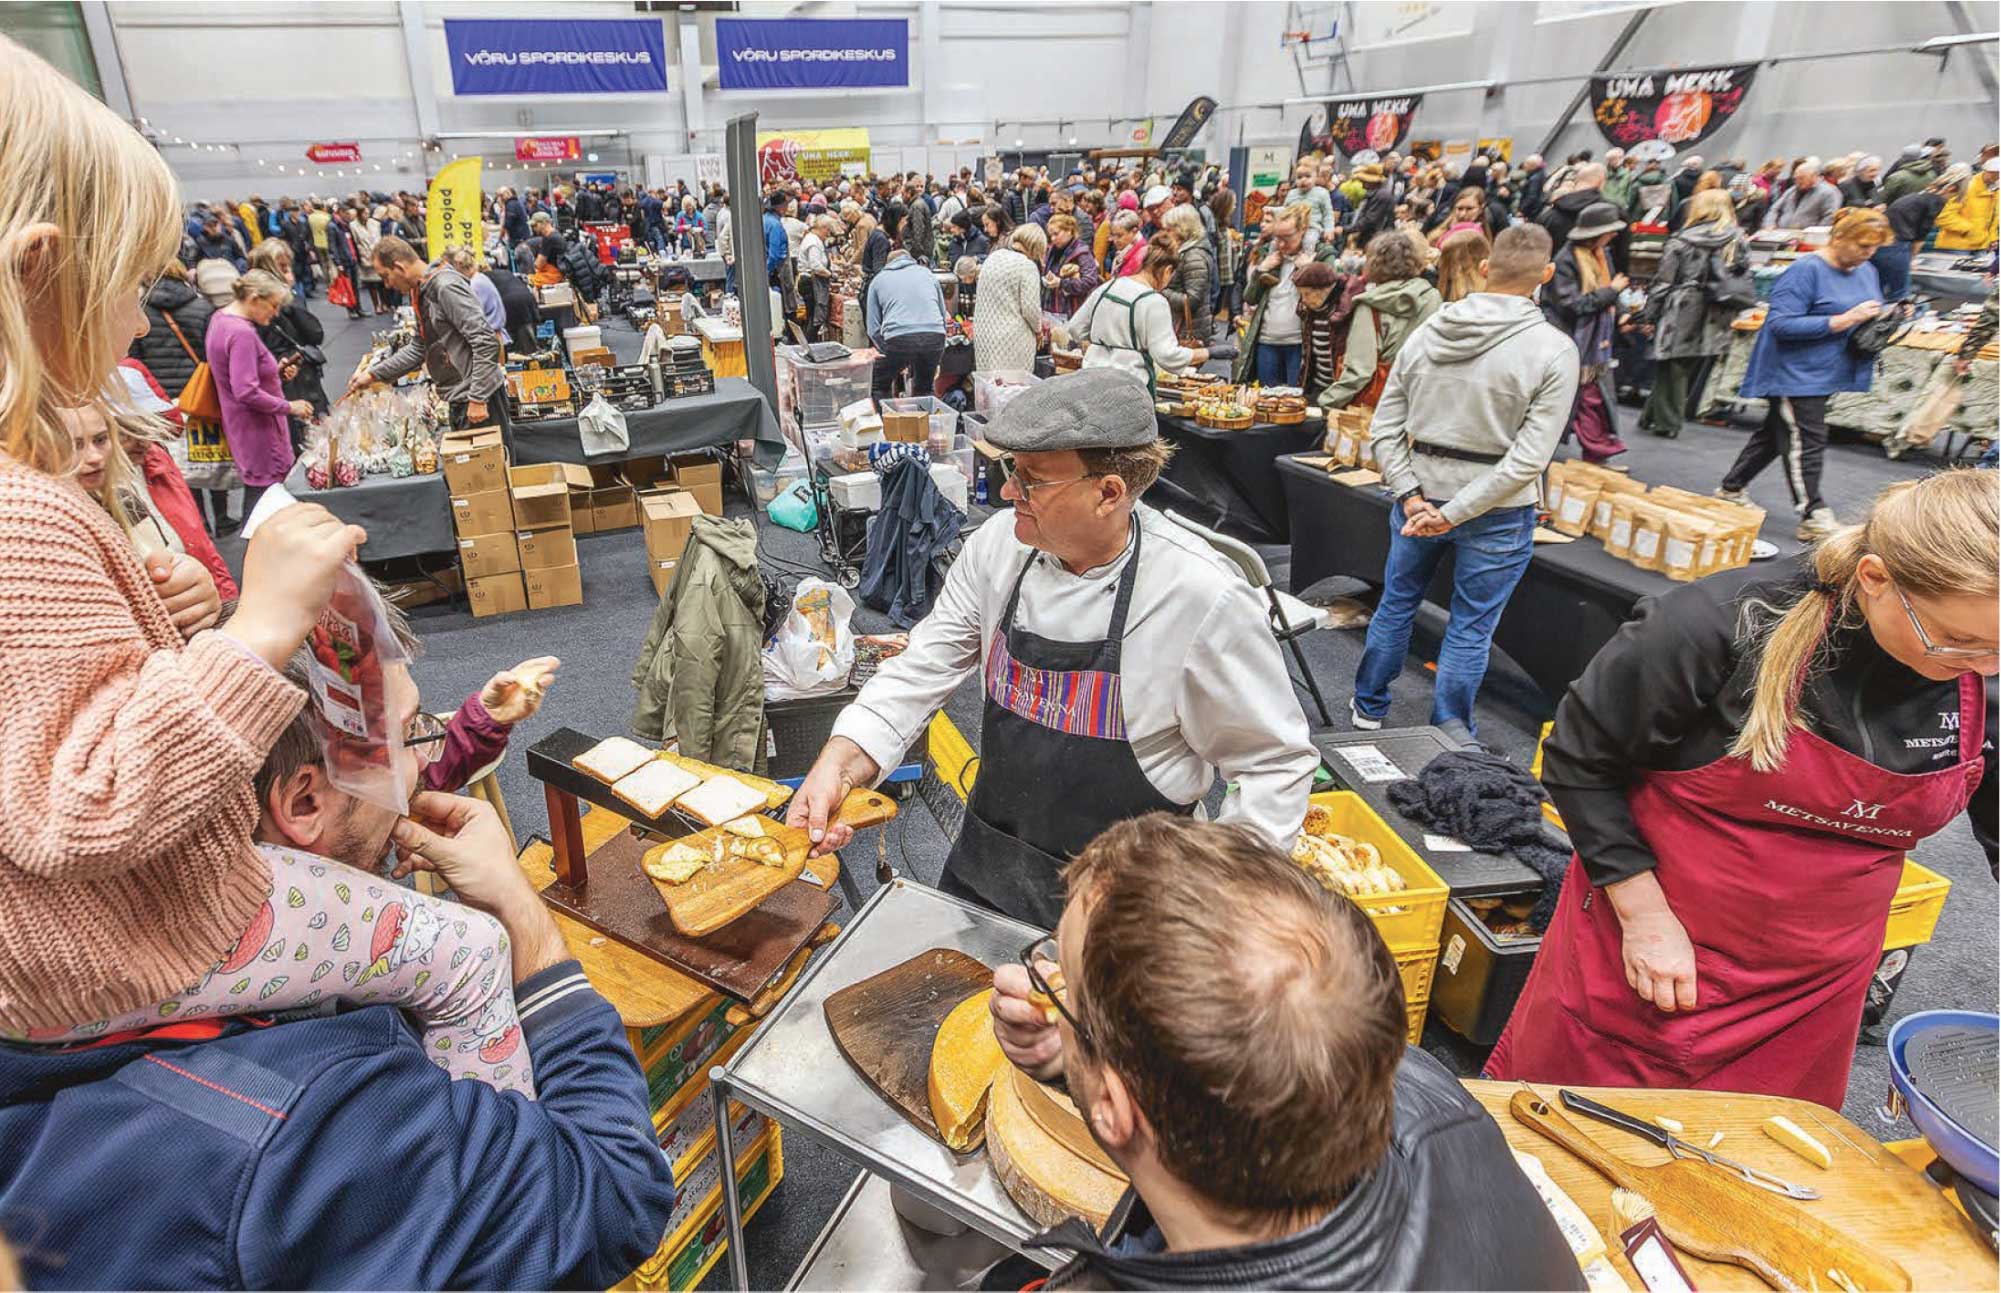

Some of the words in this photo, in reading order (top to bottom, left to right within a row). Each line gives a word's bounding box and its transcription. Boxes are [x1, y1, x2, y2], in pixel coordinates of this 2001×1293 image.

[464, 49, 516, 65] VÕRU
[518, 51, 651, 65] SPORDIKESKUS
[732, 47, 778, 62] VÕRU
[779, 48, 896, 62] SPORDIKESKUS
[1606, 75, 1655, 98] UMA
[1664, 69, 1736, 95] MEKK
[1337, 102, 1367, 118] UMA
[1371, 97, 1411, 115] MEKK
[439, 188, 456, 239] soojad
[1764, 800, 1913, 838] METSAVENNA
